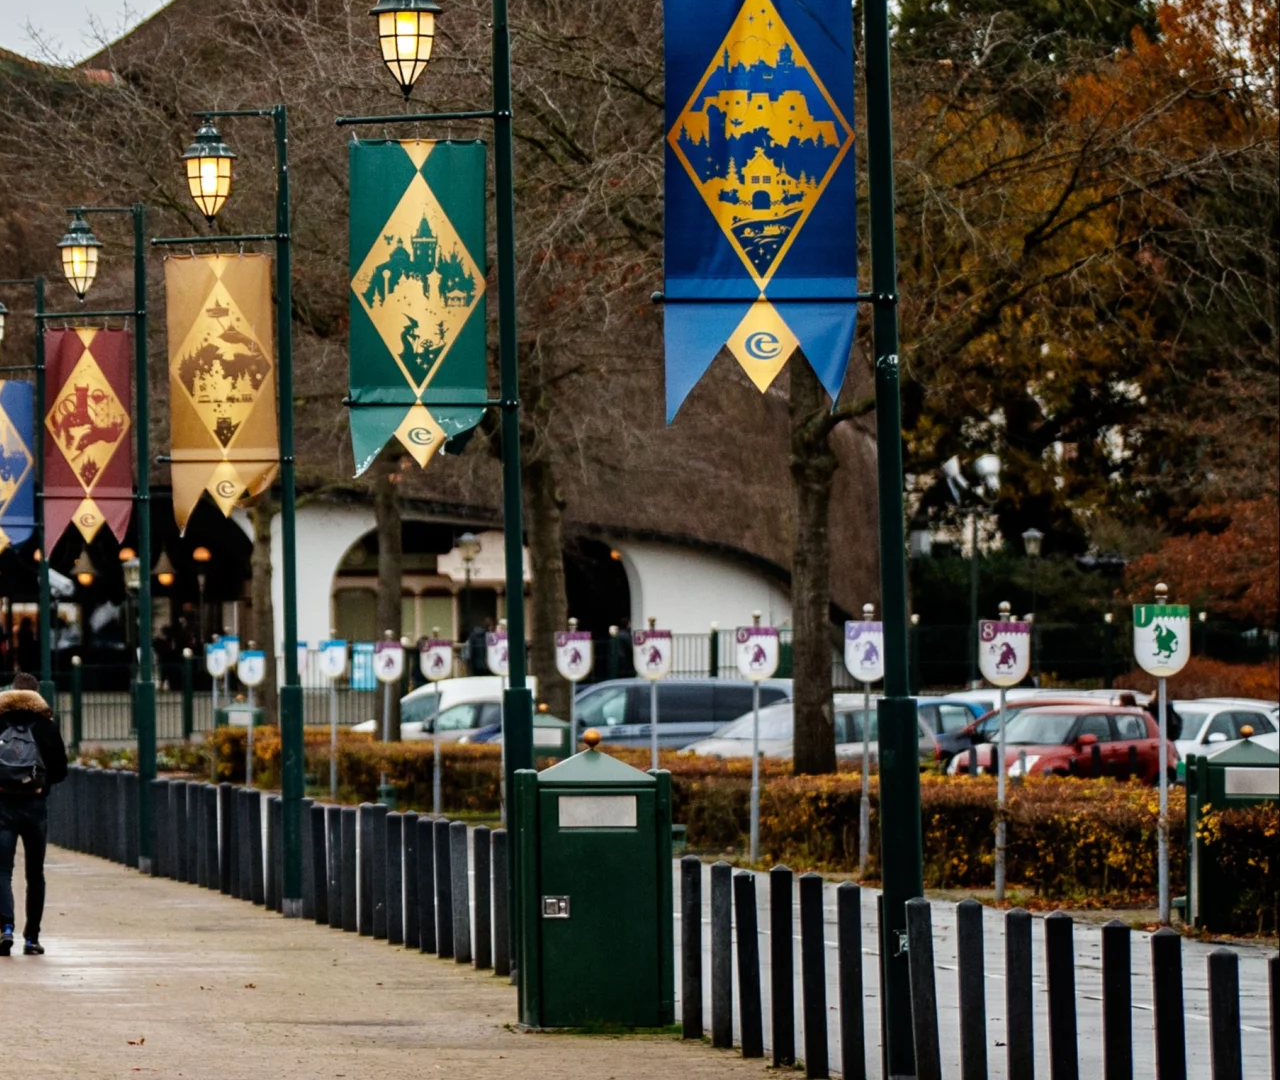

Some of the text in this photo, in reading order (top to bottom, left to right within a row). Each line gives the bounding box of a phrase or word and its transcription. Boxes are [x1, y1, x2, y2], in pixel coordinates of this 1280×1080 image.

[1140, 606, 1146, 624] 1
[848, 622, 859, 637] 7
[982, 622, 994, 639] 8
